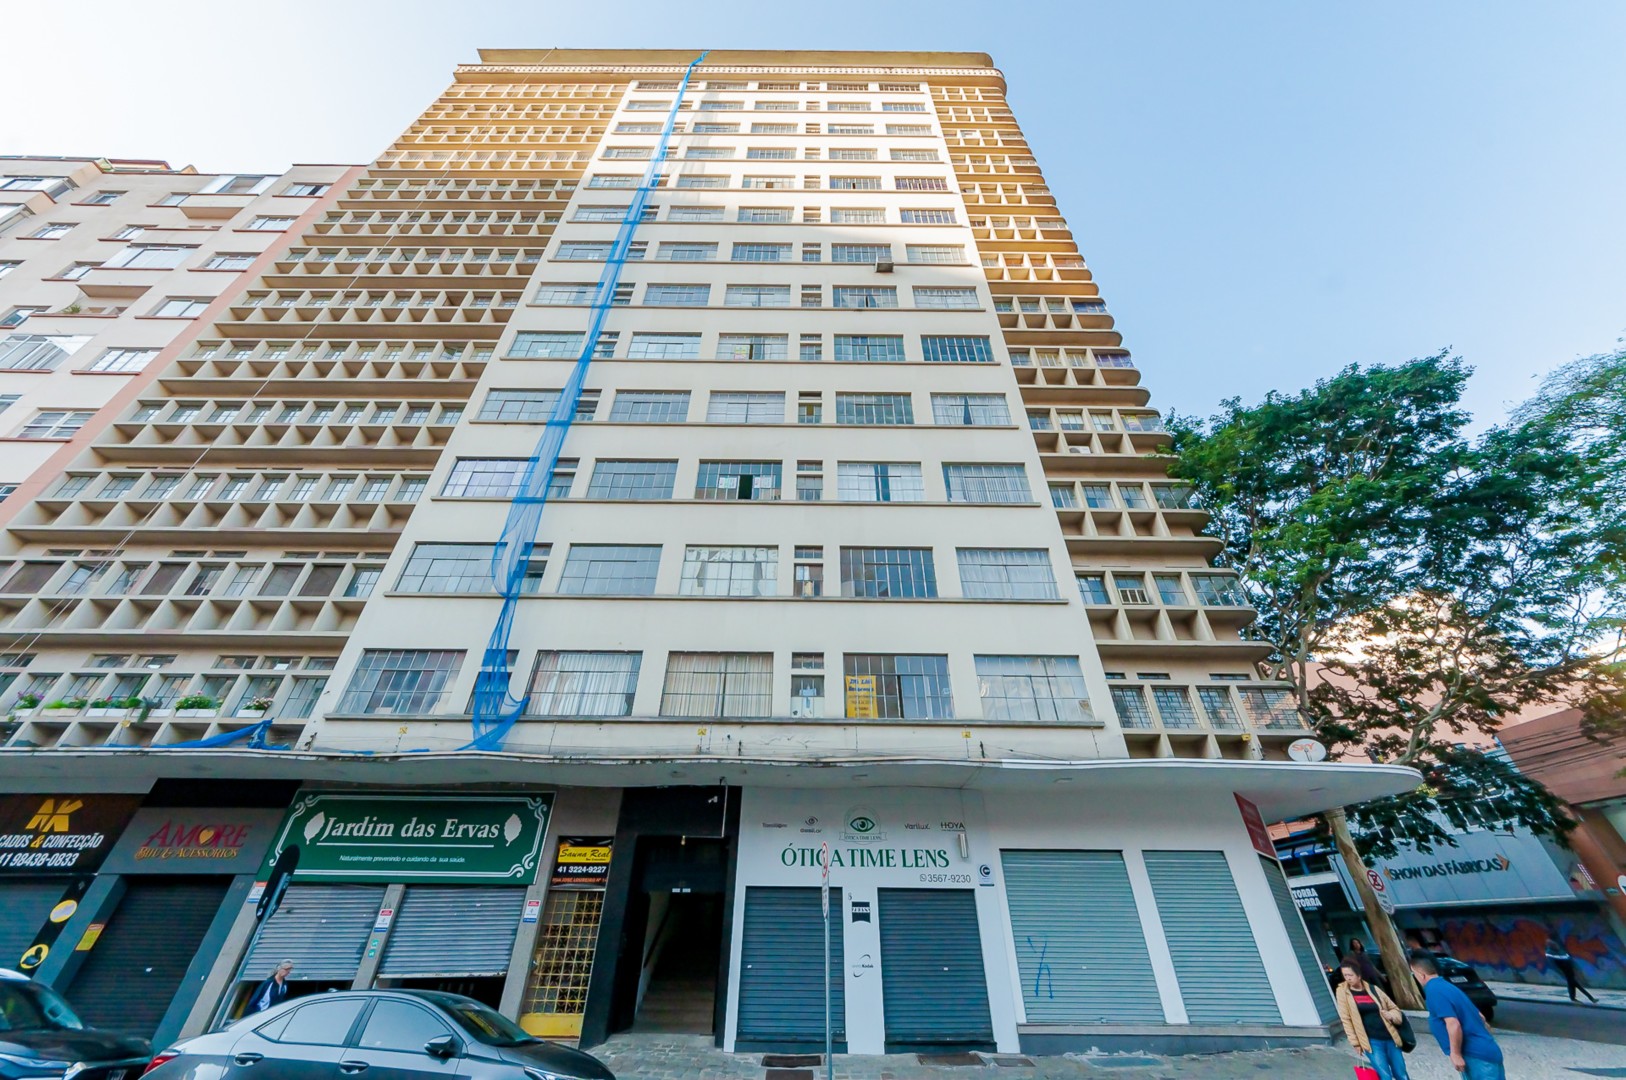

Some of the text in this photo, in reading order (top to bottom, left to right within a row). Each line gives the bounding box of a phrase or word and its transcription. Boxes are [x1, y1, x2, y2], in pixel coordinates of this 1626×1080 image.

[320, 816, 500, 841] Jardim das Ervas
[940, 821, 965, 829] HOYA
[30, 834, 46, 848] &
[42, 832, 105, 850] CONFECÇÃO
[141, 820, 252, 848] AMORE
[560, 845, 612, 858] Sauna Real
[847, 848, 896, 867] TIME
[901, 848, 950, 868] LENS
[9, 852, 80, 867] 98438-0833
[373, 855, 401, 863] prevenindo
[1391, 858, 1503, 881] SHOW DAS FÁBRICAS
[928, 874, 971, 883] 3567-9230
[1292, 888, 1318, 898] TORRA
[1295, 897, 1322, 907] TORRA
